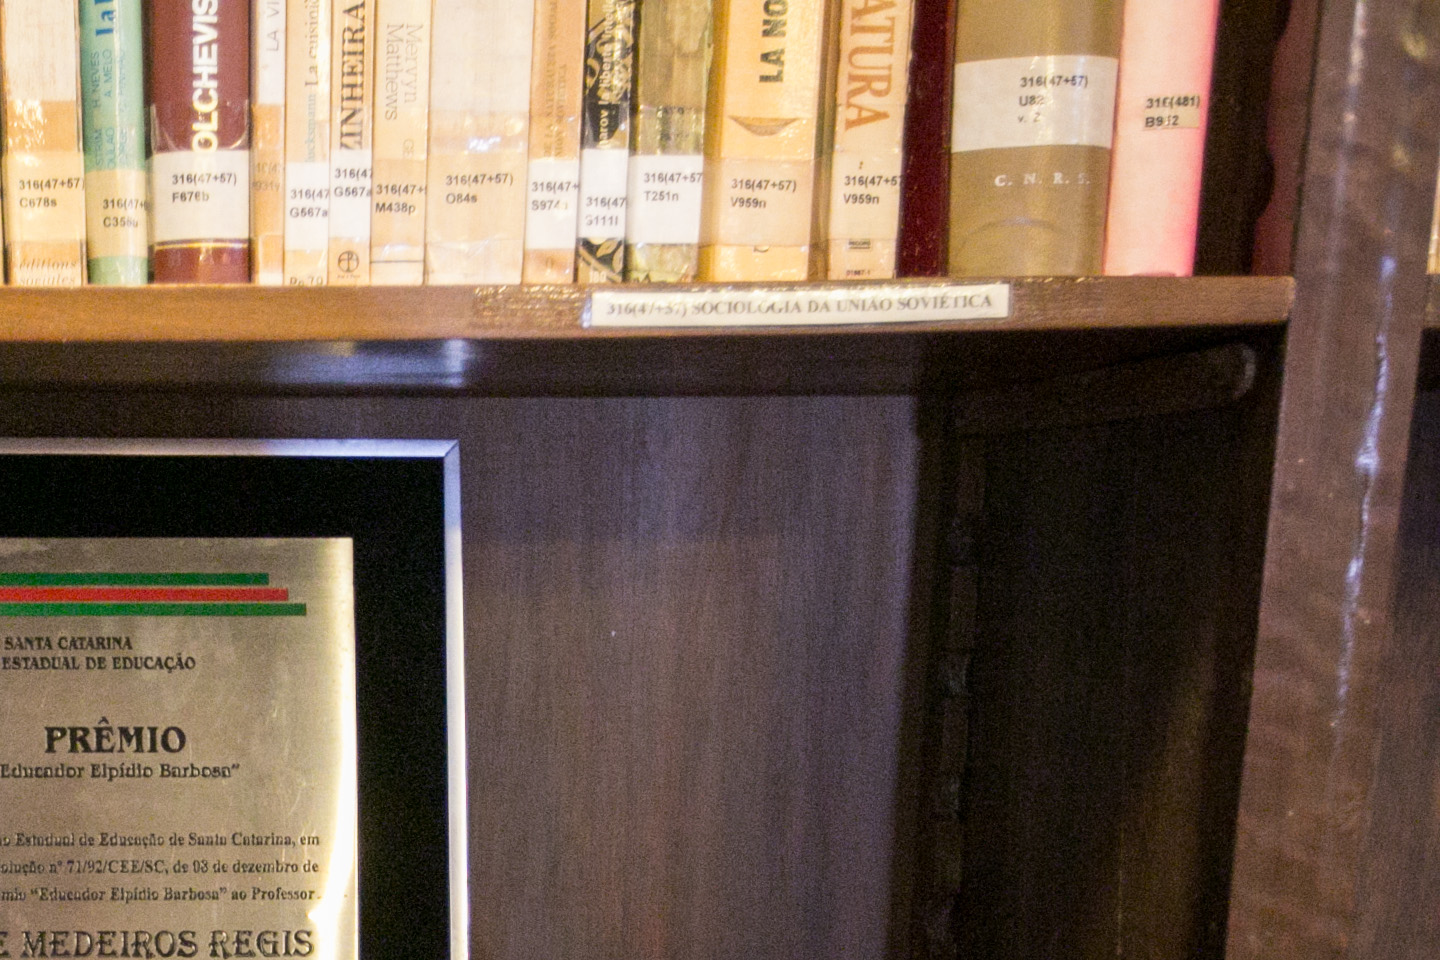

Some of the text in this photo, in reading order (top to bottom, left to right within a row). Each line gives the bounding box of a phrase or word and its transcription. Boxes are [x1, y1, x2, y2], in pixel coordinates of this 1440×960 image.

[267, 30, 279, 51] LA
[385, 23, 404, 121] Matthews
[401, 24, 423, 104] Mervyn
[759, 48, 785, 83] LA
[1020, 75, 1089, 89] 316(47+57)
[172, 172, 237, 186] 316(47+57)
[445, 173, 514, 186] 316(47+57)
[731, 179, 797, 193] 316(47+57)
[994, 174, 1013, 186] C.
[19, 197, 57, 208] C678s
[644, 190, 679, 202] T251n
[730, 197, 767, 209] V959n
[843, 193, 880, 205] V959n
[375, 202, 416, 215] M438p
[691, 297, 802, 315] SOCIOLOGIA
[807, 296, 831, 313] DA
[5, 637, 52, 650] SANTA
[57, 637, 133, 650] CATARINA
[1, 656, 80, 670] ESTADUAL
[85, 656, 107, 670] DE
[112, 653, 196, 673] EDUCAÇÃO
[44, 716, 187, 753] PRÊMIO
[90, 762, 153, 782] Elpídio
[15, 832, 75, 847] Estadual
[79, 833, 95, 846] de
[99, 832, 165, 849] Educação
[169, 832, 185, 846] de
[188, 832, 227, 846] Santa
[232, 832, 296, 848] Catarina,
[299, 836, 320, 846] em
[66, 859, 169, 875] 71/92/CEE/SC,
[173, 860, 189, 873] de
[212, 859, 229, 873] de
[233, 860, 299, 873] dezembro
[303, 860, 319, 873] de
[110, 887, 159, 904] Elpídio
[231, 891, 247, 900] ao
[20, 930, 199, 959] MEDEIROS
[209, 929, 315, 959] REGIS
